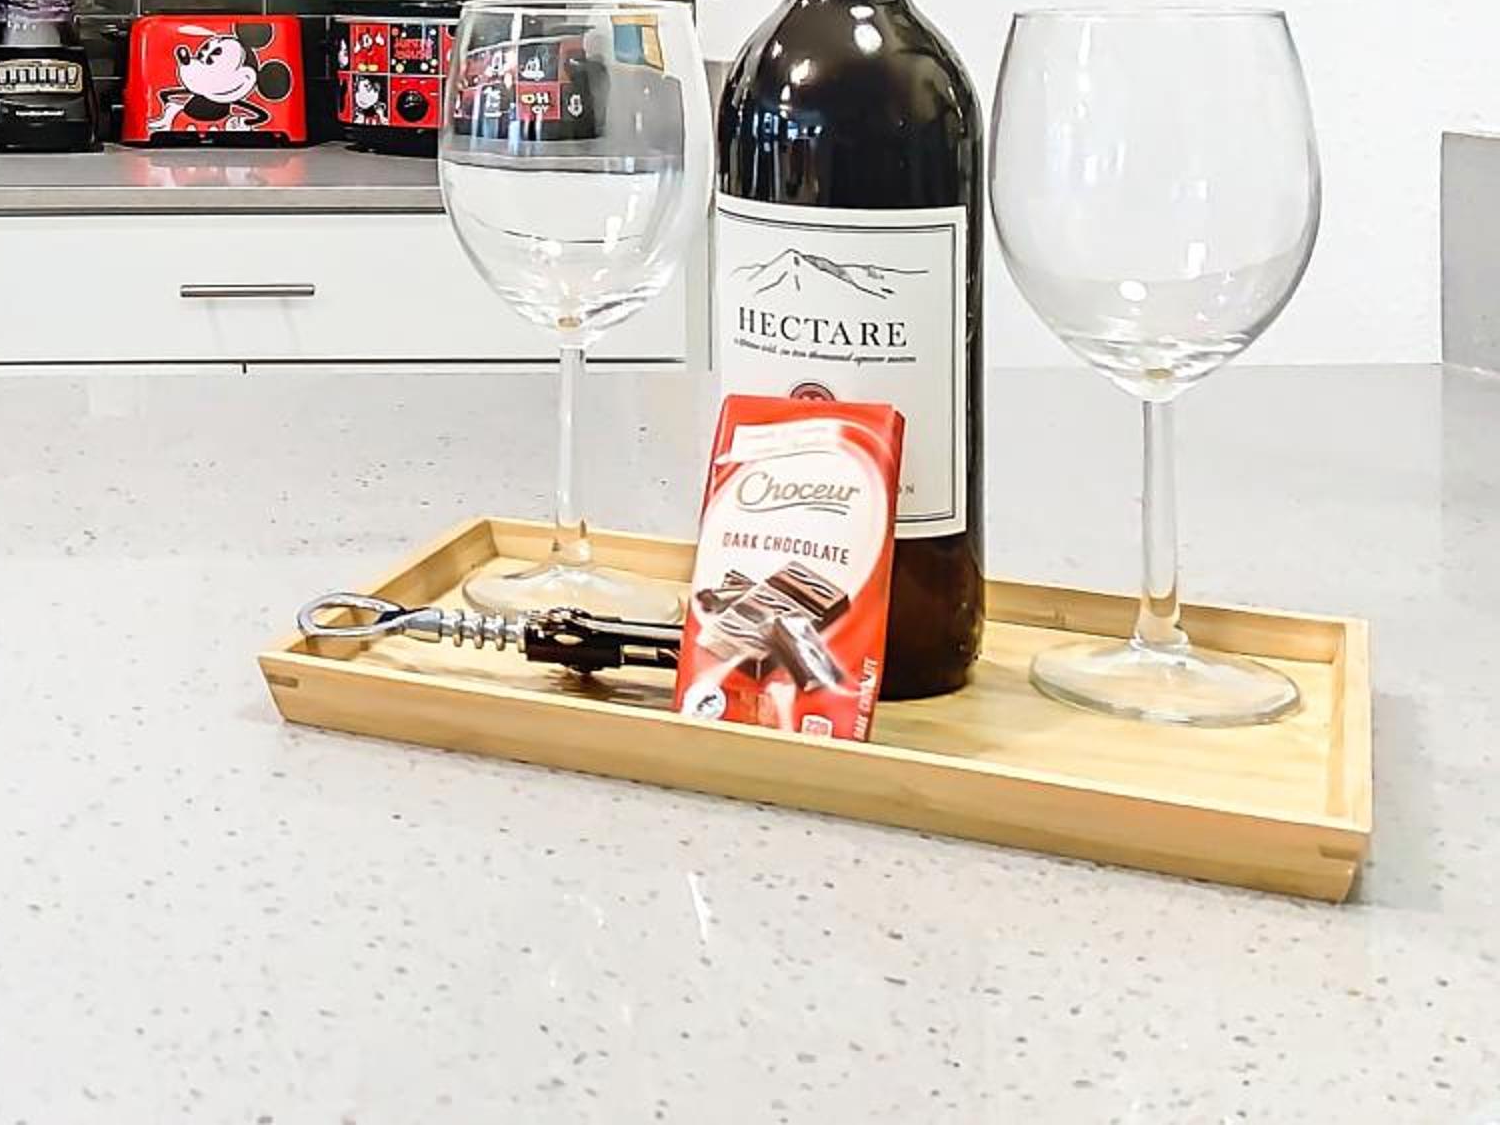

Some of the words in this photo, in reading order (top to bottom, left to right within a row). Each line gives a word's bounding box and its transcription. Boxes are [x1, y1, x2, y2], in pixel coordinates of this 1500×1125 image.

[739, 306, 907, 347] HECTARE
[736, 471, 860, 506] Choceur
[722, 531, 758, 550] DARK
[763, 535, 850, 565] CHOCOLATE
